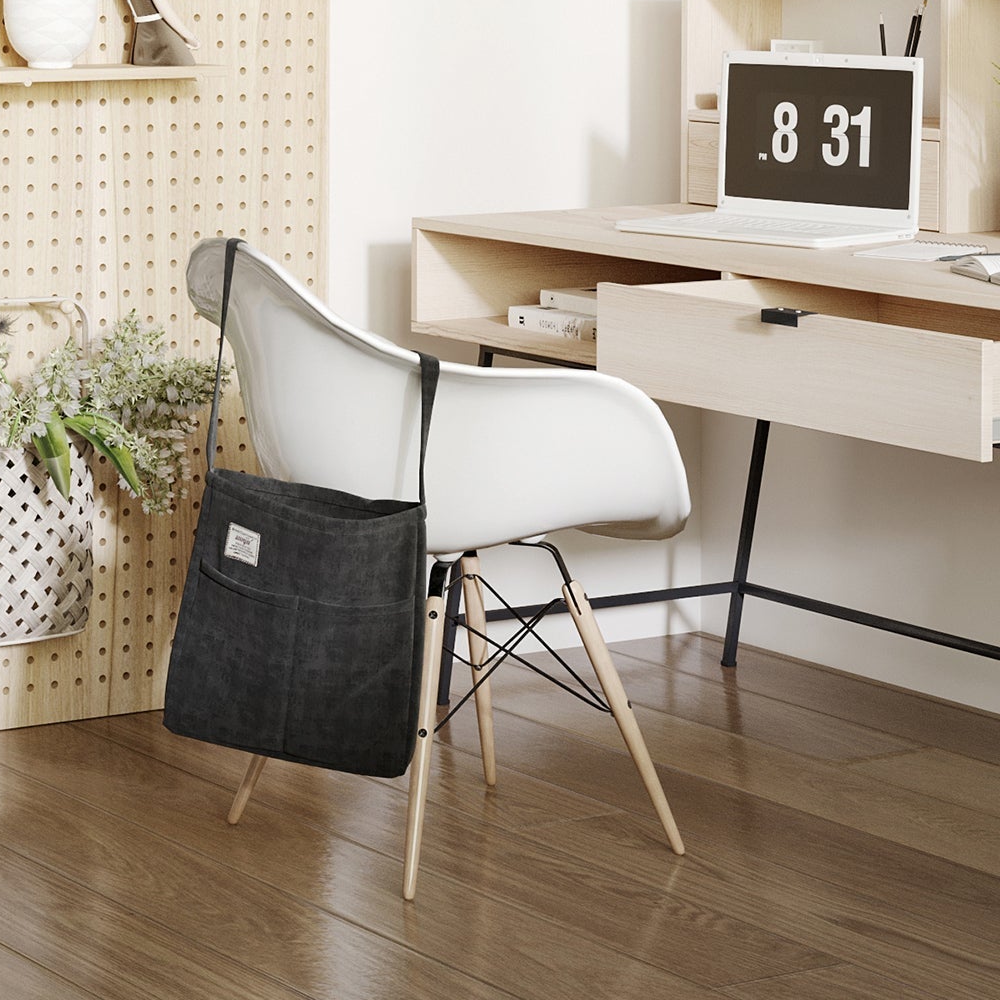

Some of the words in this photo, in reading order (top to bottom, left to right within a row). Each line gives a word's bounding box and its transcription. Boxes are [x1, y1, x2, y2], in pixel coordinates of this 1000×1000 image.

[758, 152, 768, 161] PM
[772, 101, 799, 164] 8
[822, 104, 872, 168] 31
